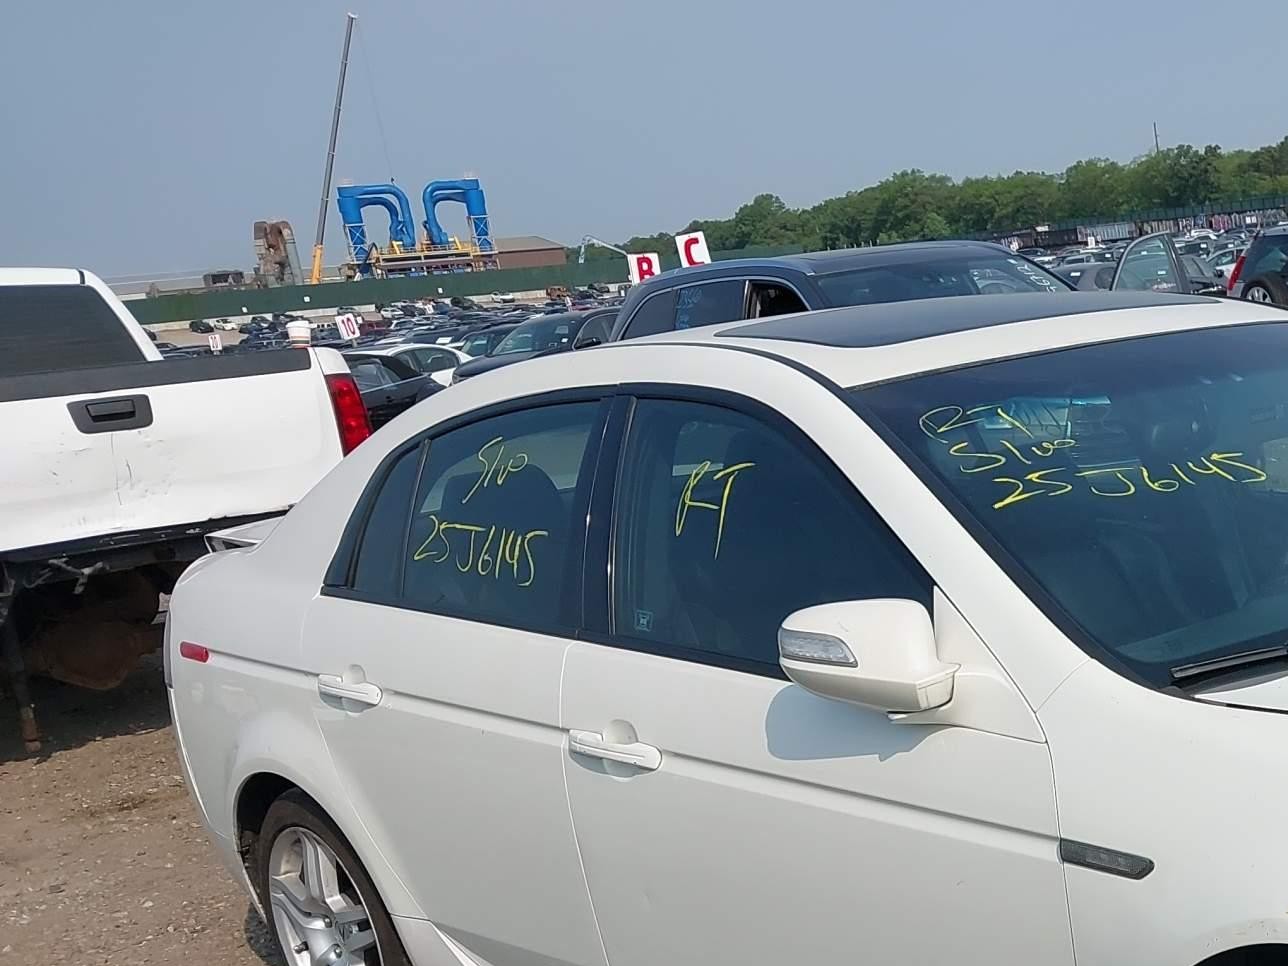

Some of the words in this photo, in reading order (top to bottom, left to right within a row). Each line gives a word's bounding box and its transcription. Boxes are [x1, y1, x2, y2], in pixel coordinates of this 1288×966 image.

[683, 237, 705, 266] C
[636, 256, 655, 282] B
[341, 316, 356, 337] 10
